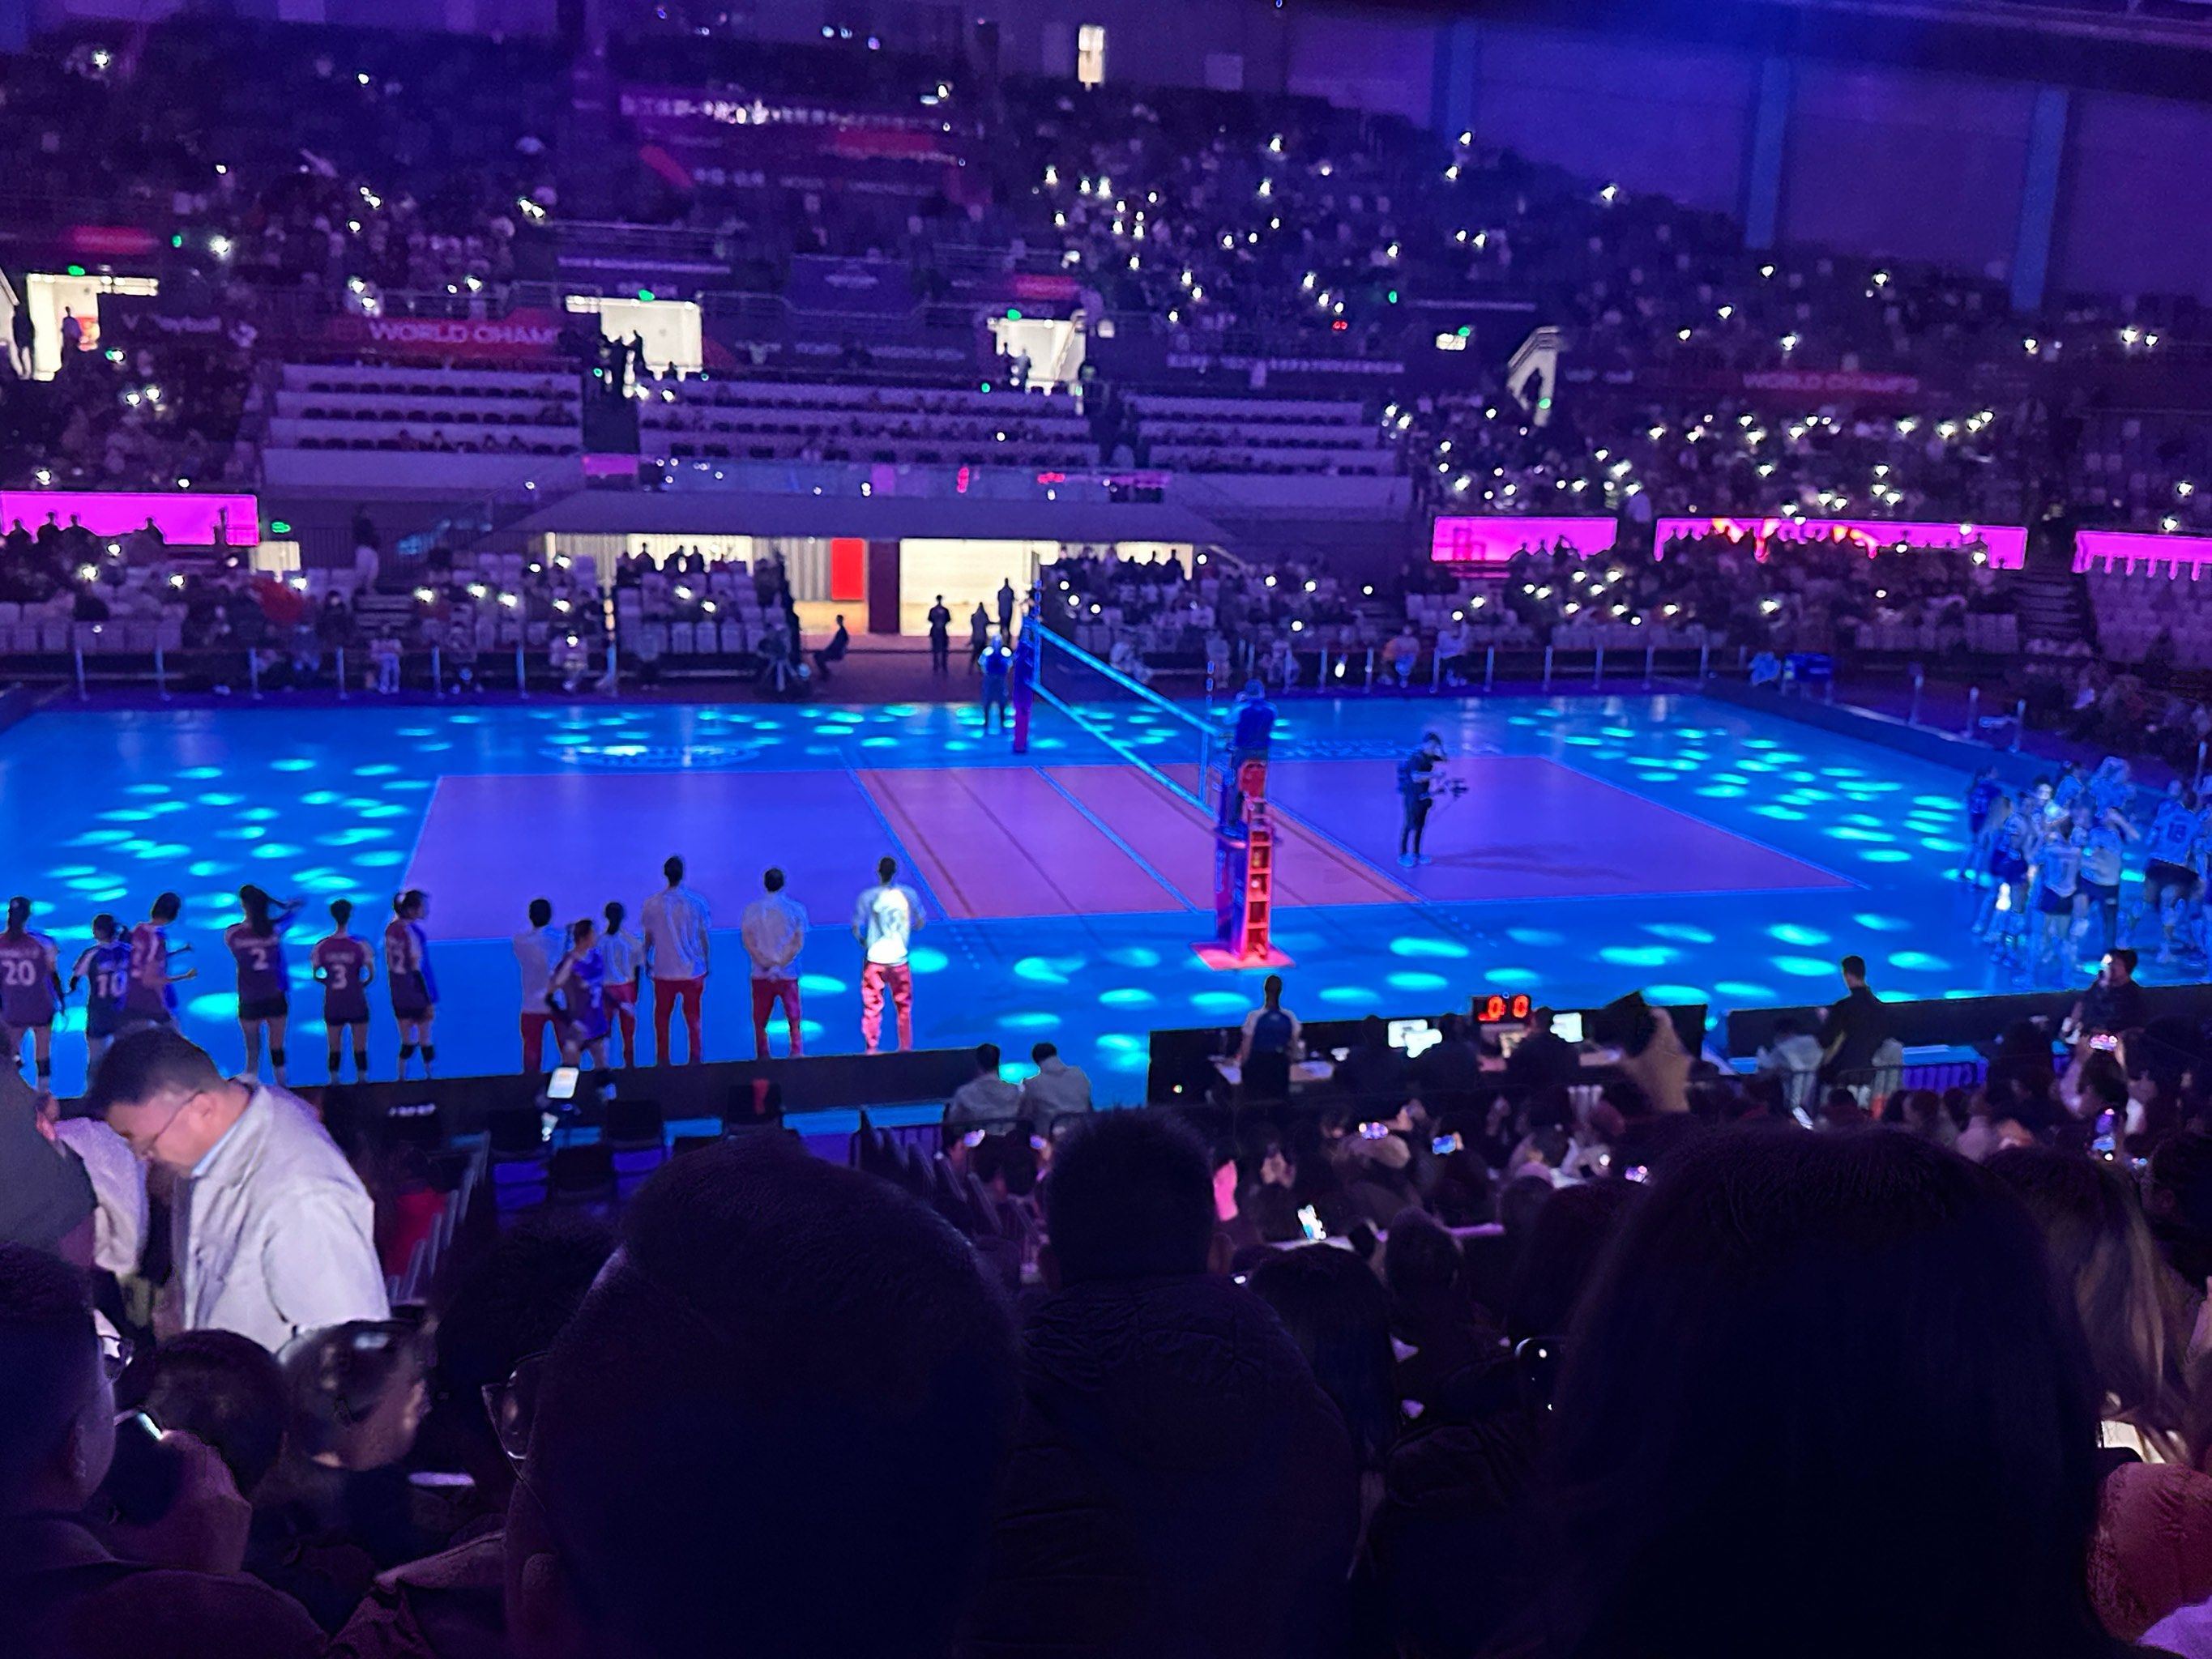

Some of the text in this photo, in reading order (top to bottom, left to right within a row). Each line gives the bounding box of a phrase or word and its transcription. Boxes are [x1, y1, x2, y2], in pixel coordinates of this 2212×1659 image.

[369, 322, 559, 343] WORLD CHAM
[1, 959, 36, 987] 20
[249, 948, 269, 971] 2
[96, 971, 128, 999] 10
[331, 963, 348, 990] 3
